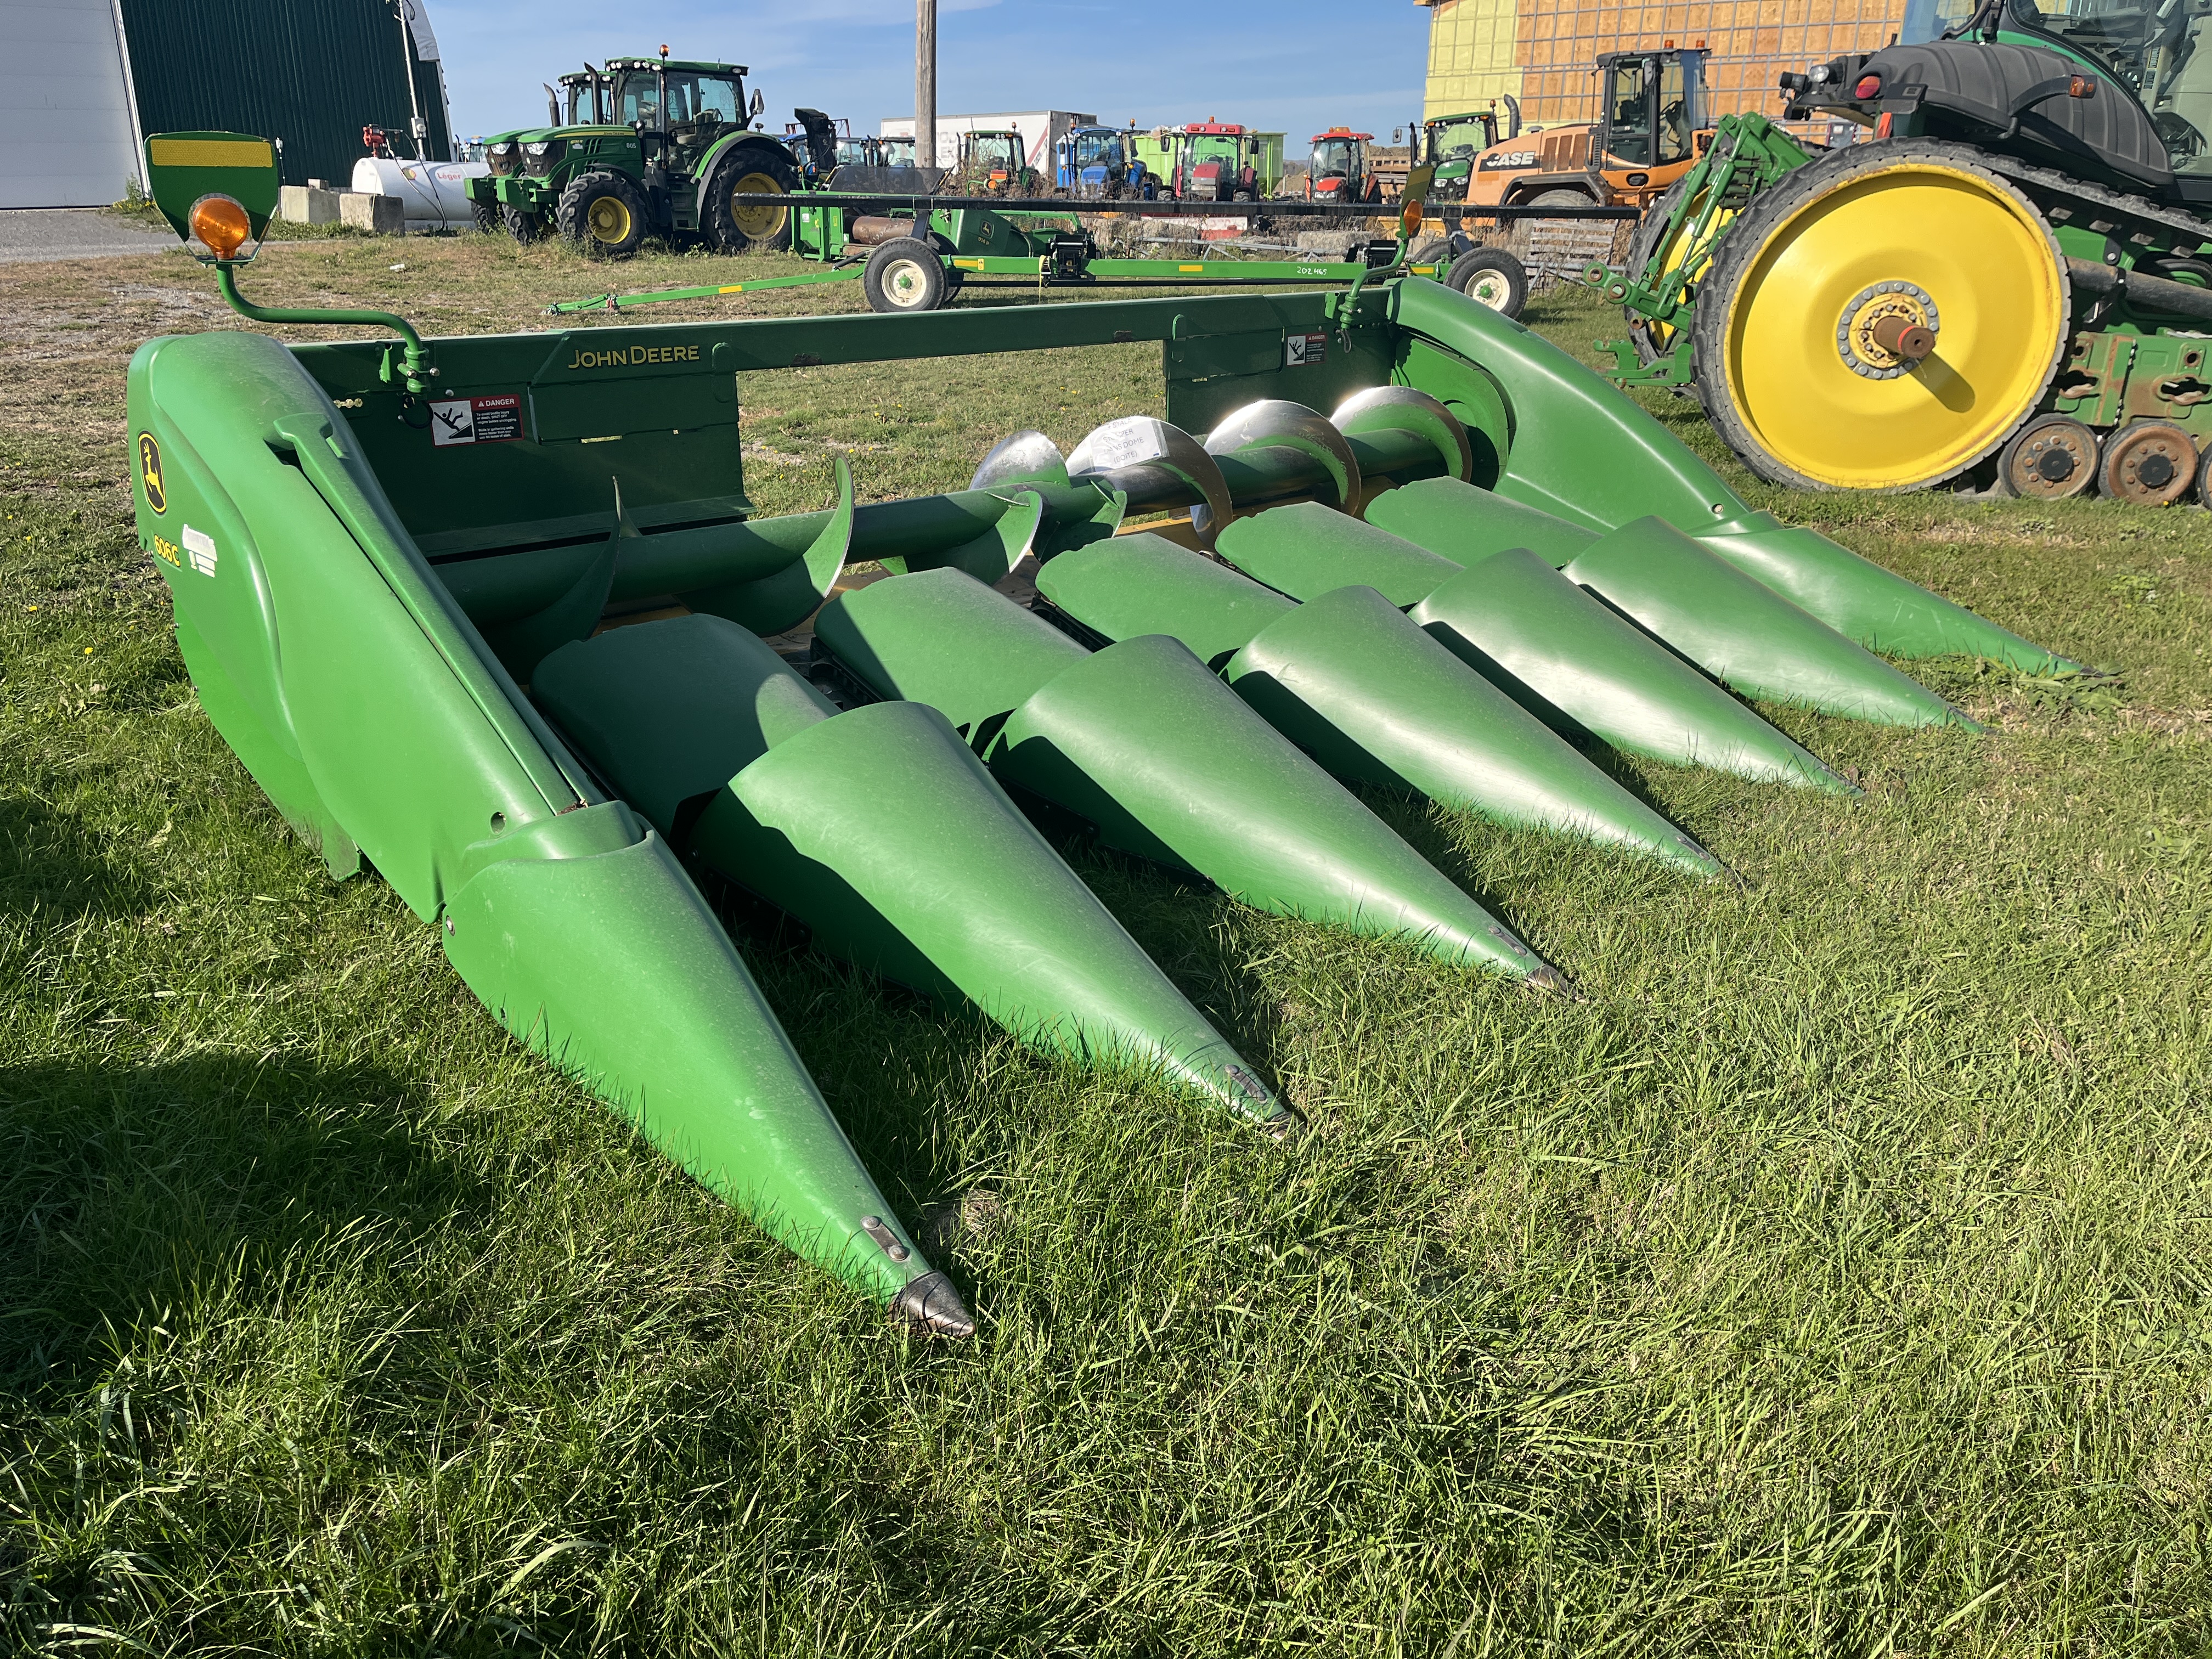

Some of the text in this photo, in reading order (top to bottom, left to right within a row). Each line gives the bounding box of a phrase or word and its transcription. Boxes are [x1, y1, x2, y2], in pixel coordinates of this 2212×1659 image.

[1486, 151, 1536, 167] CASE
[437, 172, 461, 181] Léger
[568, 346, 699, 369] JOHN DEERE
[486, 398, 515, 407] DANGER
[1123, 437, 1144, 448] DOME
[1114, 450, 1138, 464] (BOITE)
[154, 534, 180, 567] 606C
